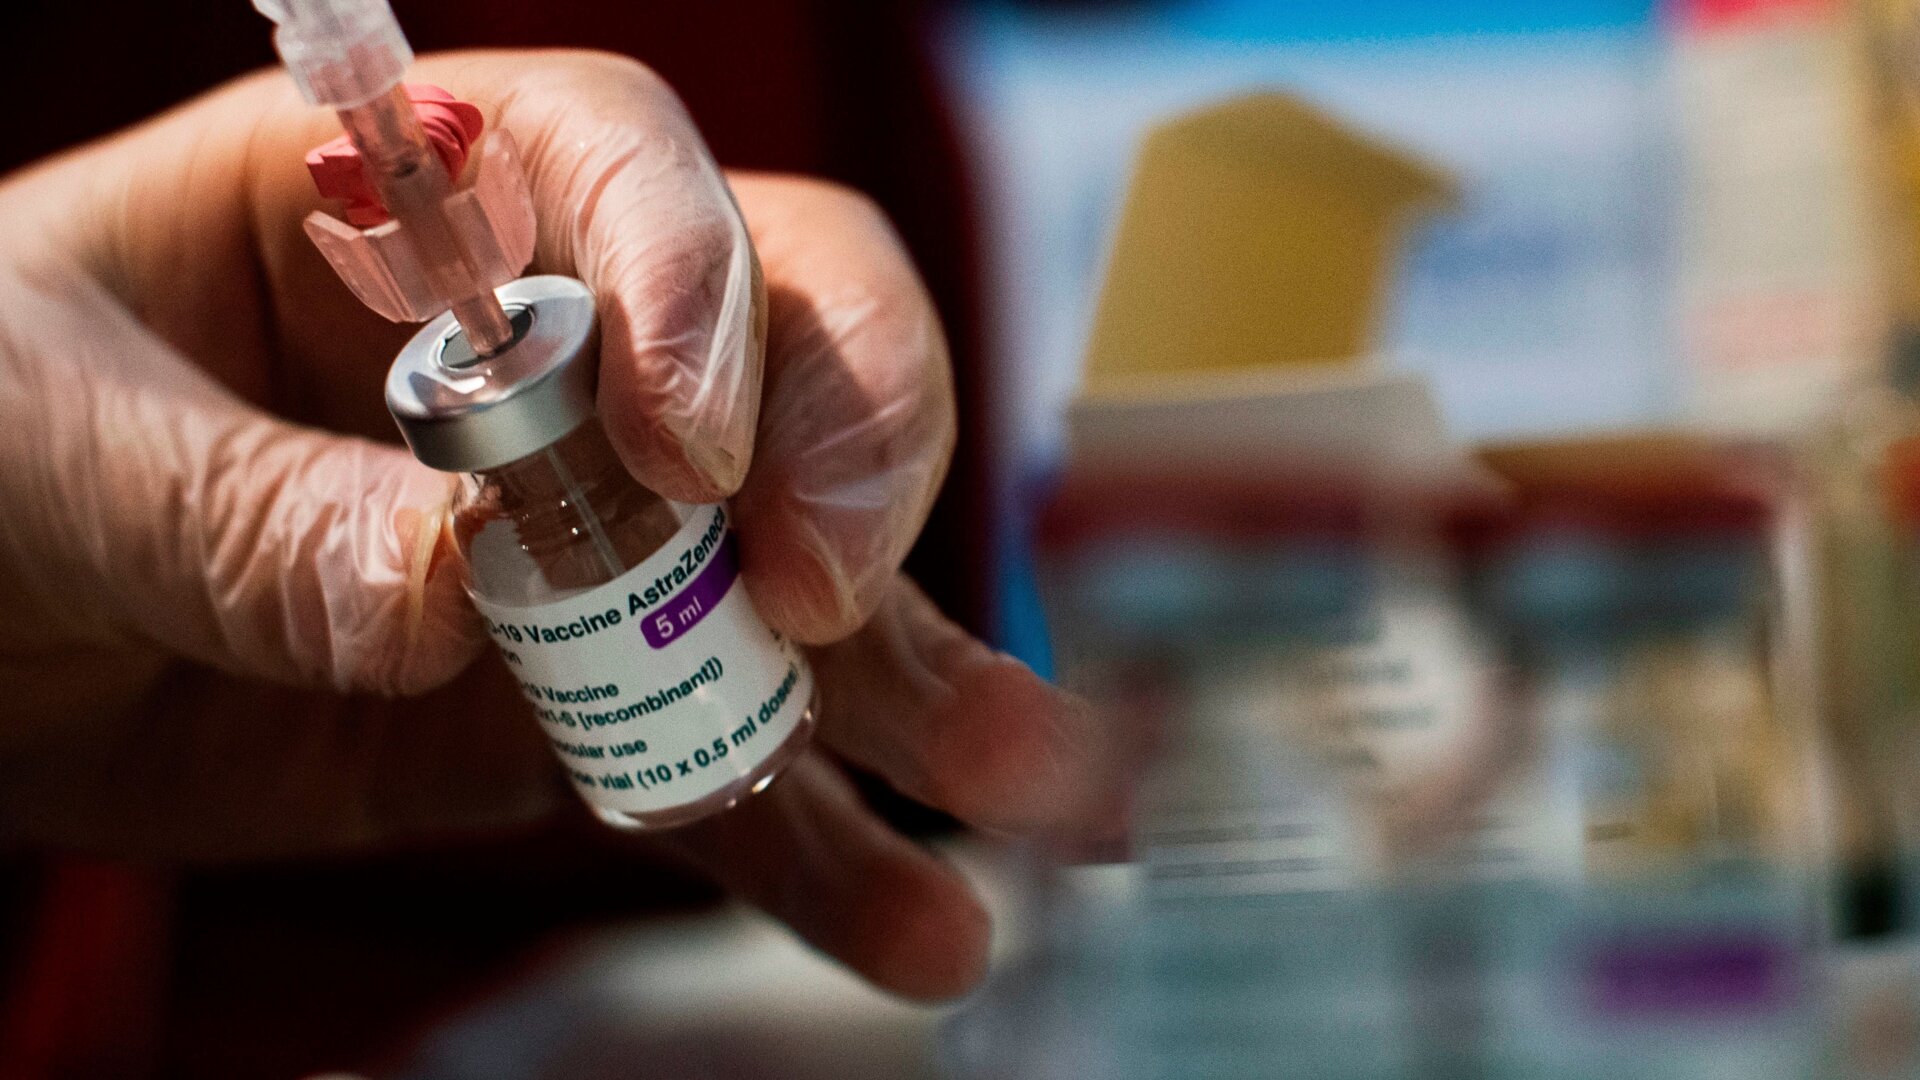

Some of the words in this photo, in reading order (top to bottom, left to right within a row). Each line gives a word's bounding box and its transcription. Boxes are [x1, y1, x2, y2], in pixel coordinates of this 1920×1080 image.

[523, 607, 622, 644] Vaccine
[628, 506, 726, 616] AstraZeneca
[655, 613, 675, 638] 5
[678, 595, 703, 626] ml
[541, 683, 620, 703] Vaccine
[577, 656, 723, 732] [recombinant])
[598, 772, 635, 789] vial
[636, 764, 673, 791] (10
[676, 759, 693, 777] x
[693, 738, 729, 768] 0.5
[730, 716, 757, 747] ml
[609, 739, 648, 758] use
